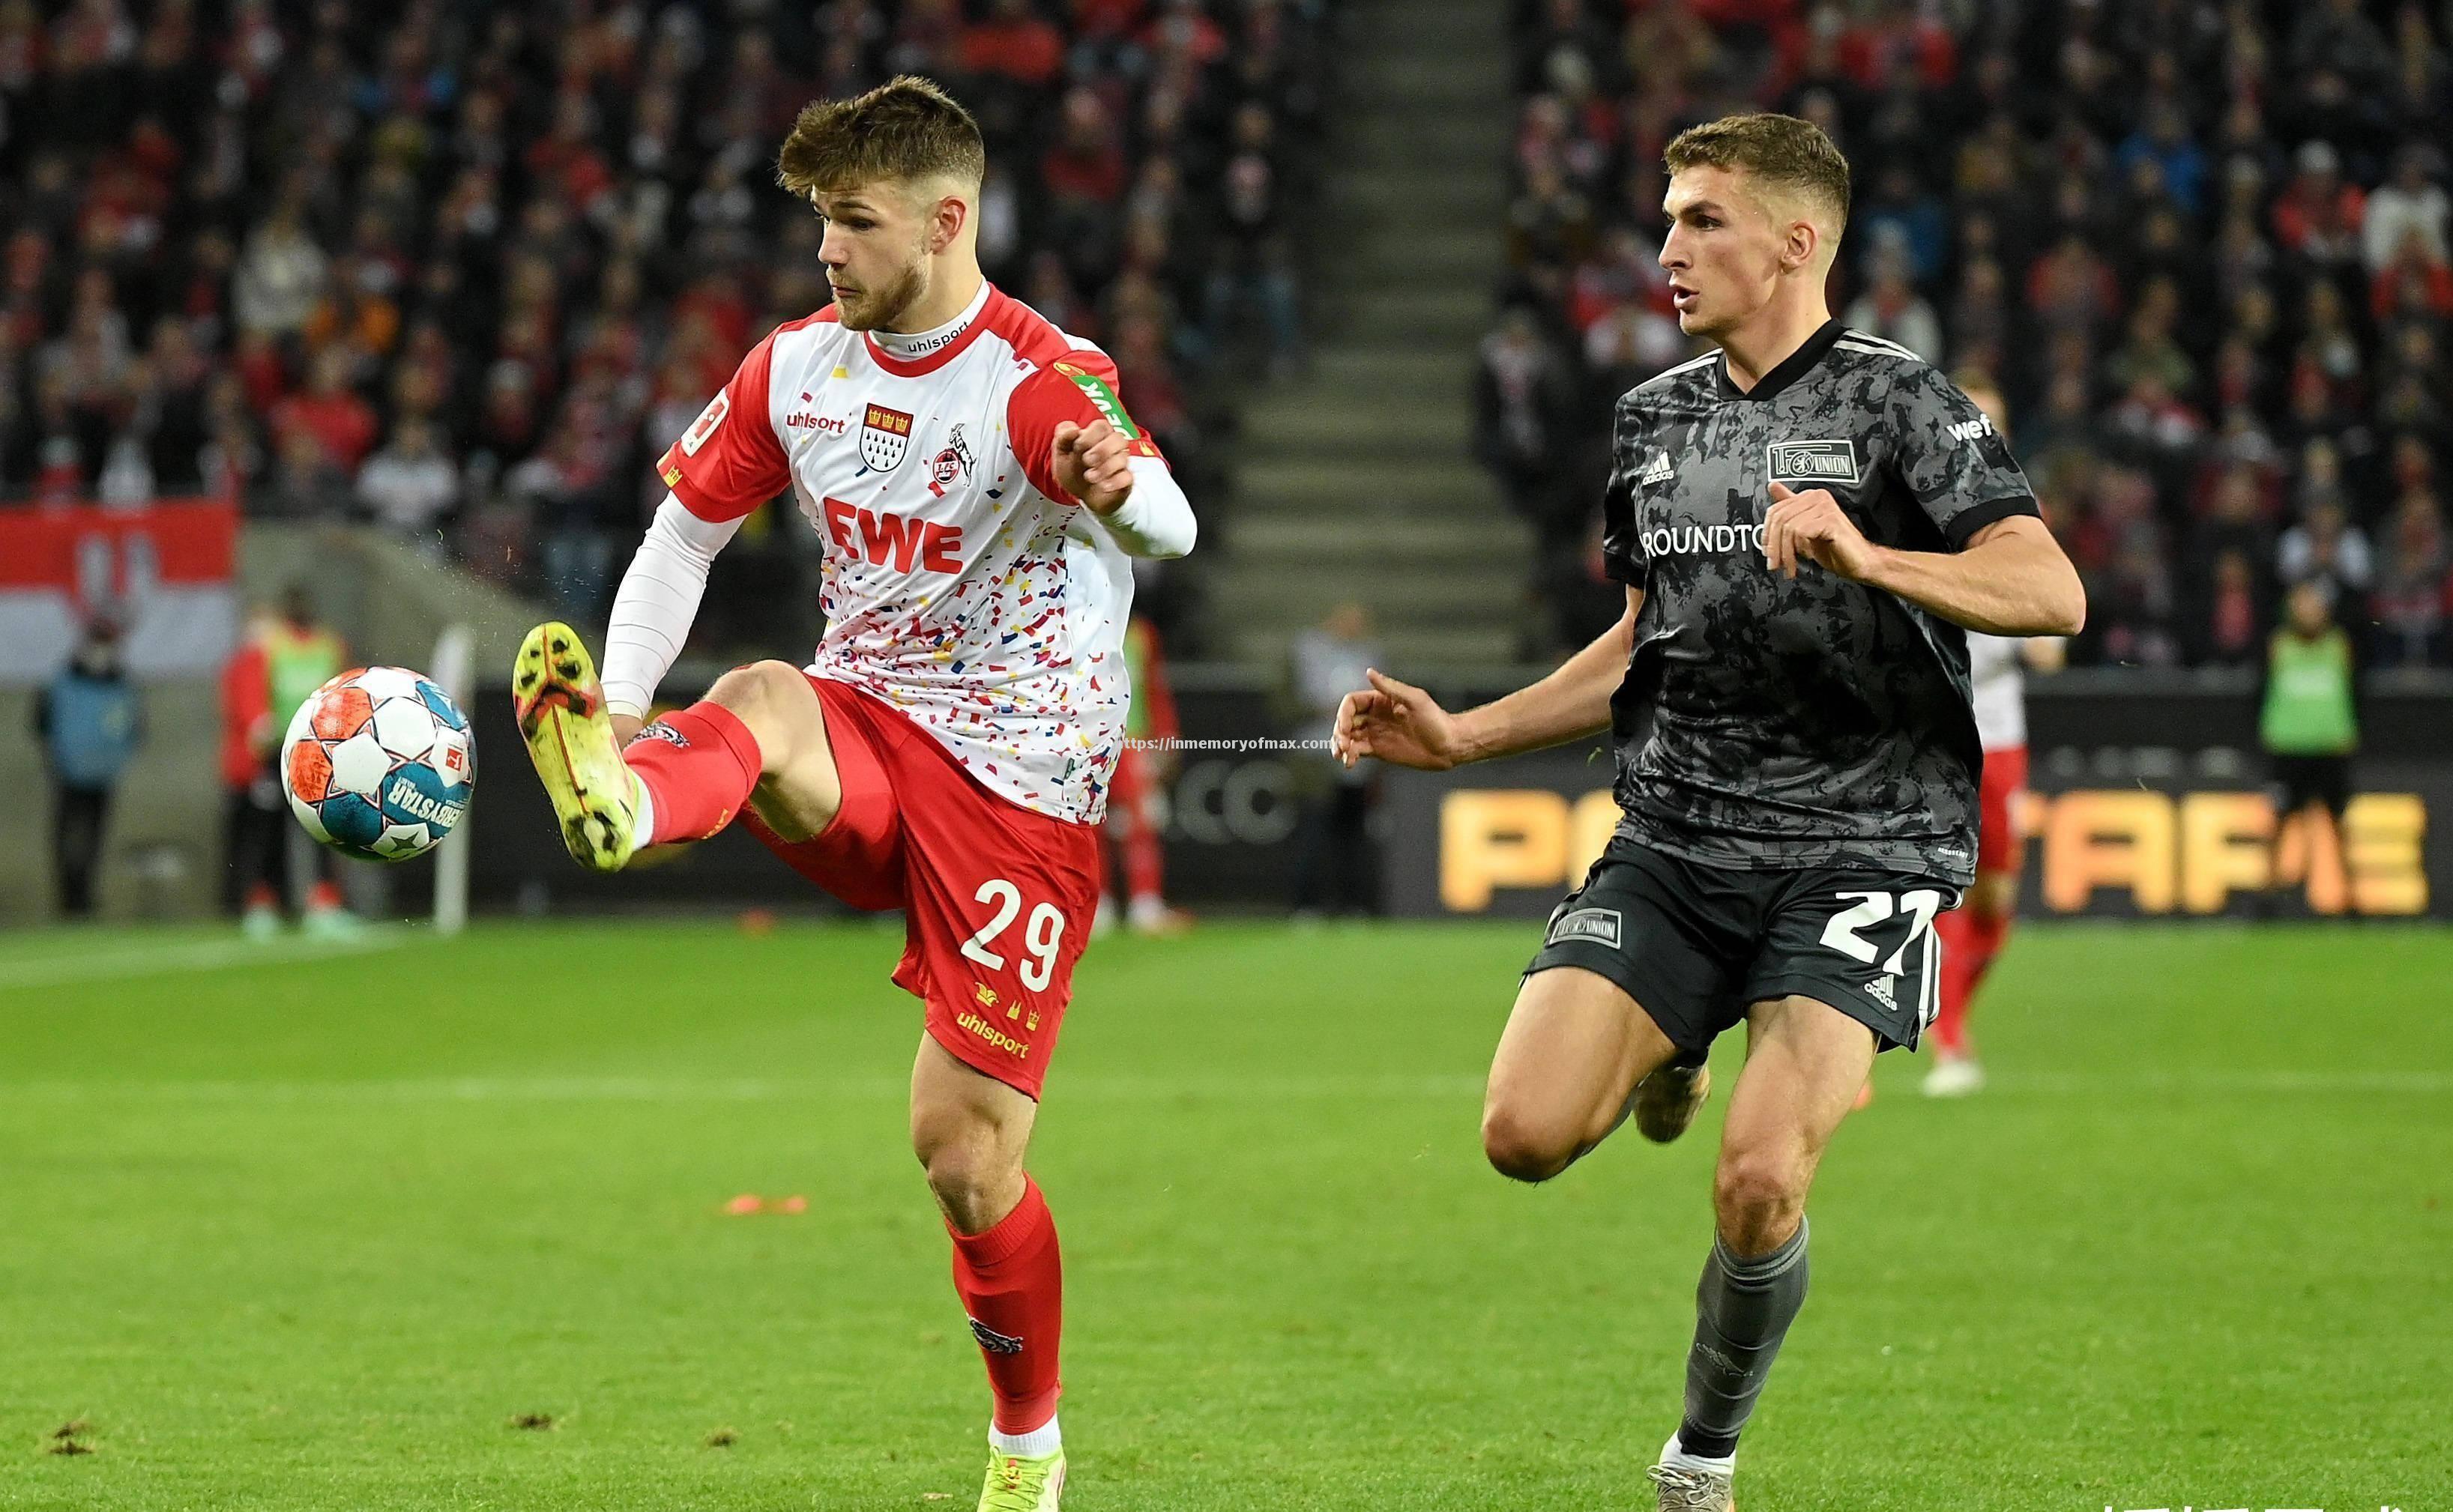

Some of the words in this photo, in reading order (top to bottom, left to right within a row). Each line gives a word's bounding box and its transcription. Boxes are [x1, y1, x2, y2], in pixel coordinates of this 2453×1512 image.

[908, 321, 969, 352] uhlsport
[1642, 470, 1675, 486] adidas
[1814, 456, 1850, 474] UNION
[823, 496, 964, 575] EWE
[1640, 523, 1764, 560] ROUNDTO
[387, 781, 465, 828] ERBYSTAR
[960, 878, 1066, 993] 29
[1864, 982, 1898, 1011] adidas
[956, 1009, 1031, 1059] uhlsport
